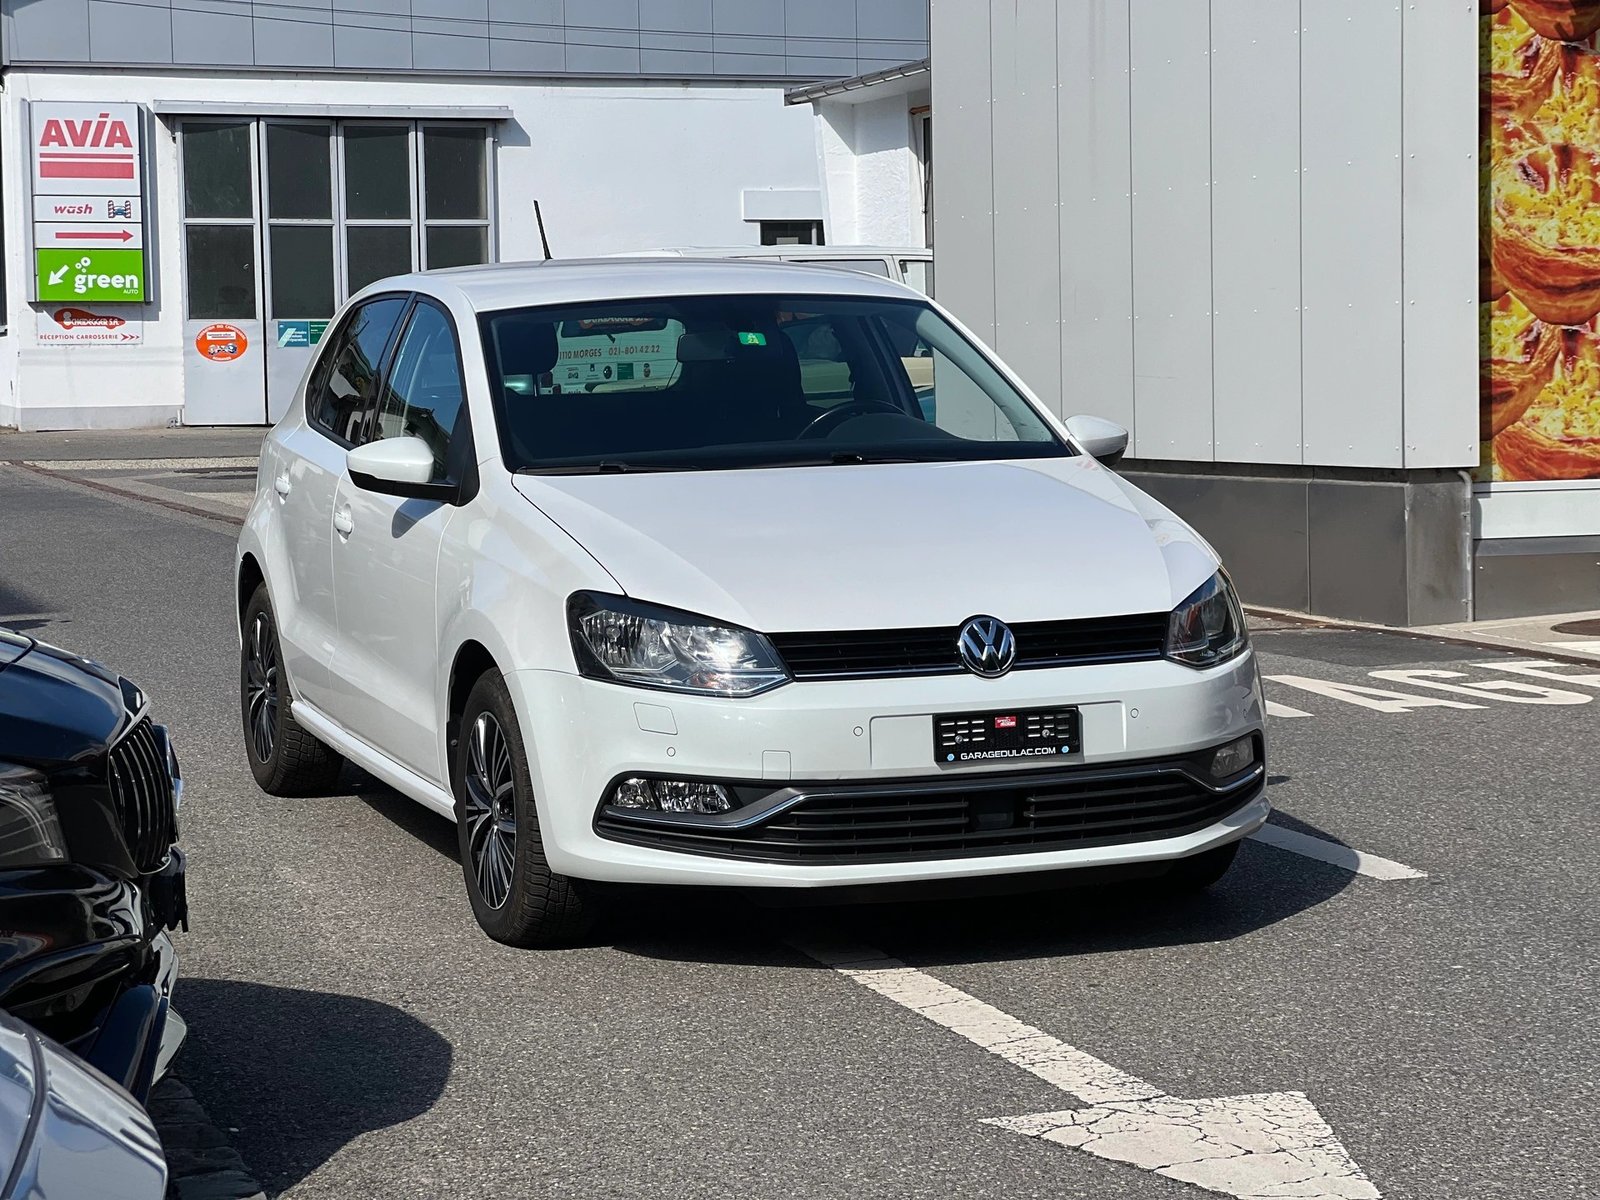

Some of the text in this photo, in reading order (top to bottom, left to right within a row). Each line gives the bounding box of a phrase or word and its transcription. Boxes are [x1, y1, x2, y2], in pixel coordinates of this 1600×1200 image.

[54, 204, 93, 214] wash
[74, 274, 139, 294] green
[573, 348, 602, 359] MORGES
[960, 746, 1056, 760] GARAGEDULAC.COM
